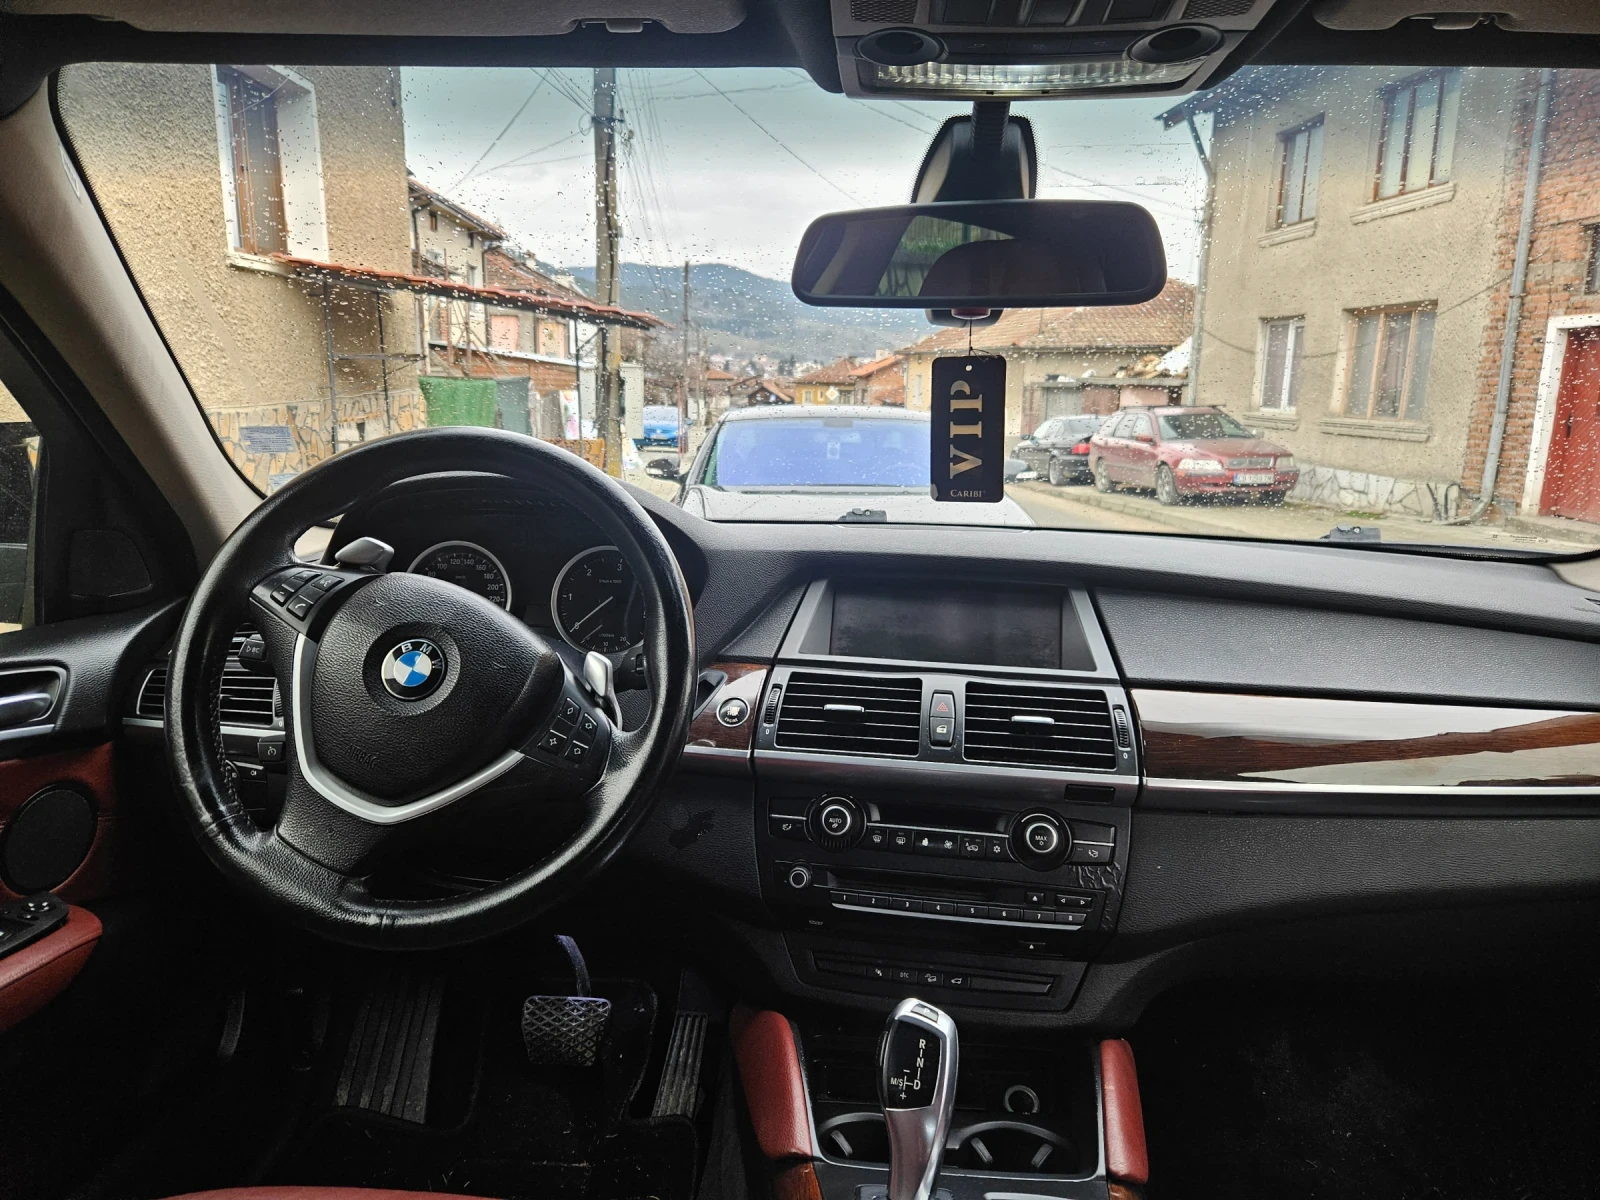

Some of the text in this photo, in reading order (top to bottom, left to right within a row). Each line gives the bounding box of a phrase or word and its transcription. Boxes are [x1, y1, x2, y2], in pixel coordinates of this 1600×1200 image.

[950, 380, 983, 480] VIP
[950, 489, 982, 498] CARIBI
[616, 564, 622, 572] 3
[401, 642, 442, 668] BMW
[344, 745, 380, 770] AIRBAG
[919, 1039, 926, 1049] R
[916, 1057, 924, 1068] N
[890, 1077, 903, 1087] M/S
[913, 1080, 921, 1090] D
